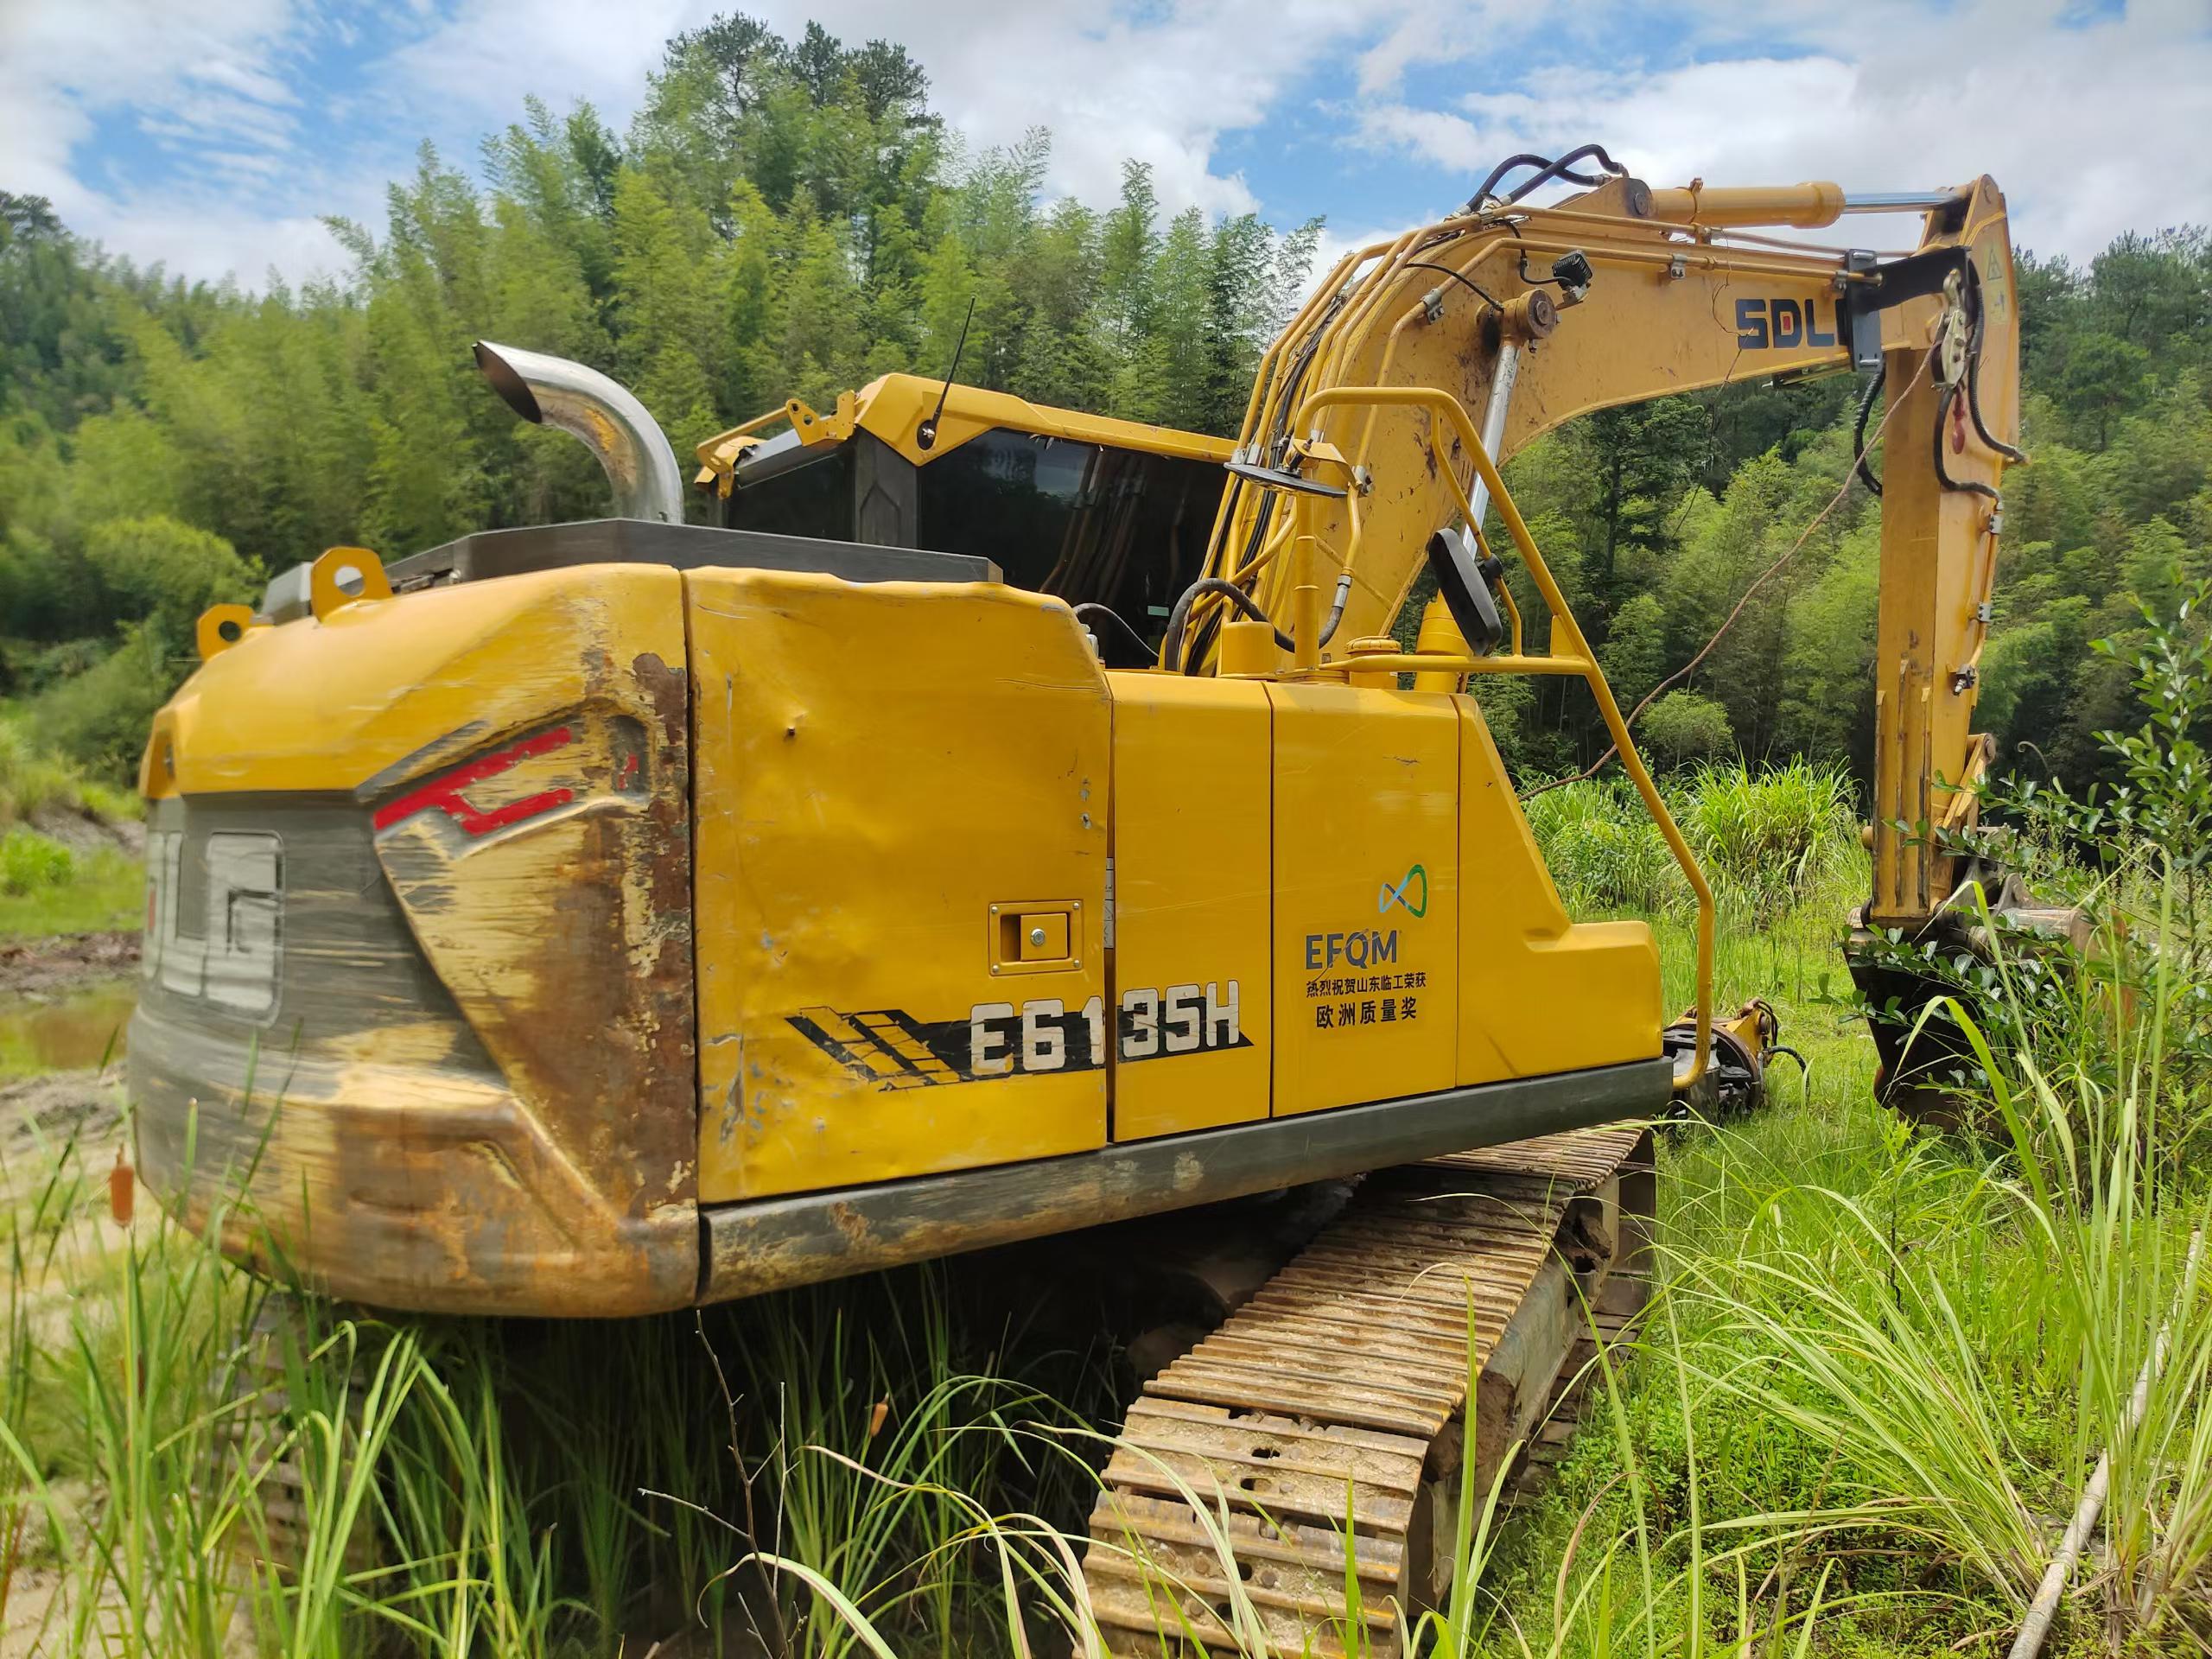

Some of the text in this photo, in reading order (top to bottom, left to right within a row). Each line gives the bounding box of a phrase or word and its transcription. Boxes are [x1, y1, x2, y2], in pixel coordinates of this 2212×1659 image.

[1306, 930, 1397, 969] EFQM
[1306, 972, 1427, 998] 热烈祝贺山东临工荣获
[970, 979, 1240, 1076] E6135H
[1316, 996, 1417, 1029] 欧洲质量奖
